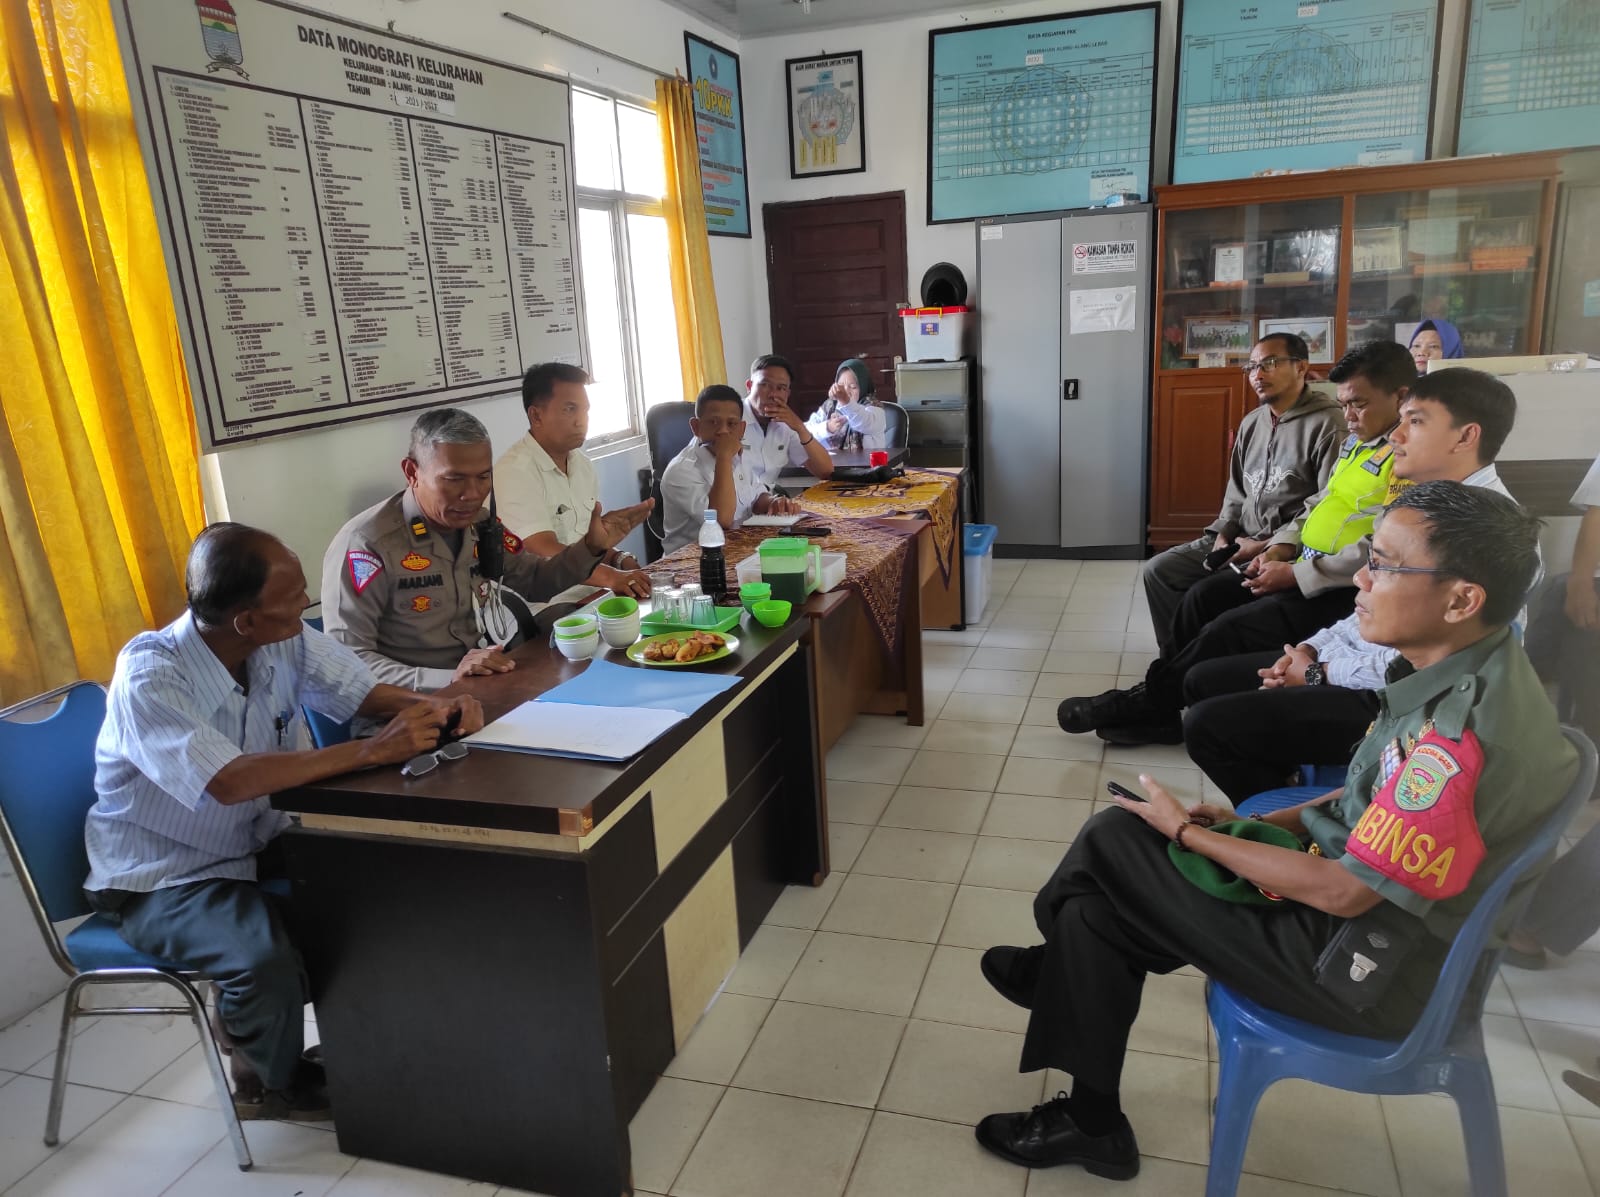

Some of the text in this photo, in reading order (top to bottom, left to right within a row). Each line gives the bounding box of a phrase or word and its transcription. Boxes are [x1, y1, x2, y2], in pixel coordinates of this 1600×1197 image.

[297, 25, 484, 85] DATA MONOGRAFI KELURAHAN
[343, 57, 385, 75] KELURAHAN
[390, 70, 411, 82] ALANG
[415, 75, 436, 87] ALANG
[436, 79, 454, 91] LEBAR
[345, 70, 386, 88] KECAMATAN
[392, 82, 413, 93] ALANG
[417, 87, 437, 99] ALANG
[437, 91, 455, 102] LEBAR
[347, 83, 371, 96] TAHUN
[399, 574, 444, 590] MARJANI
